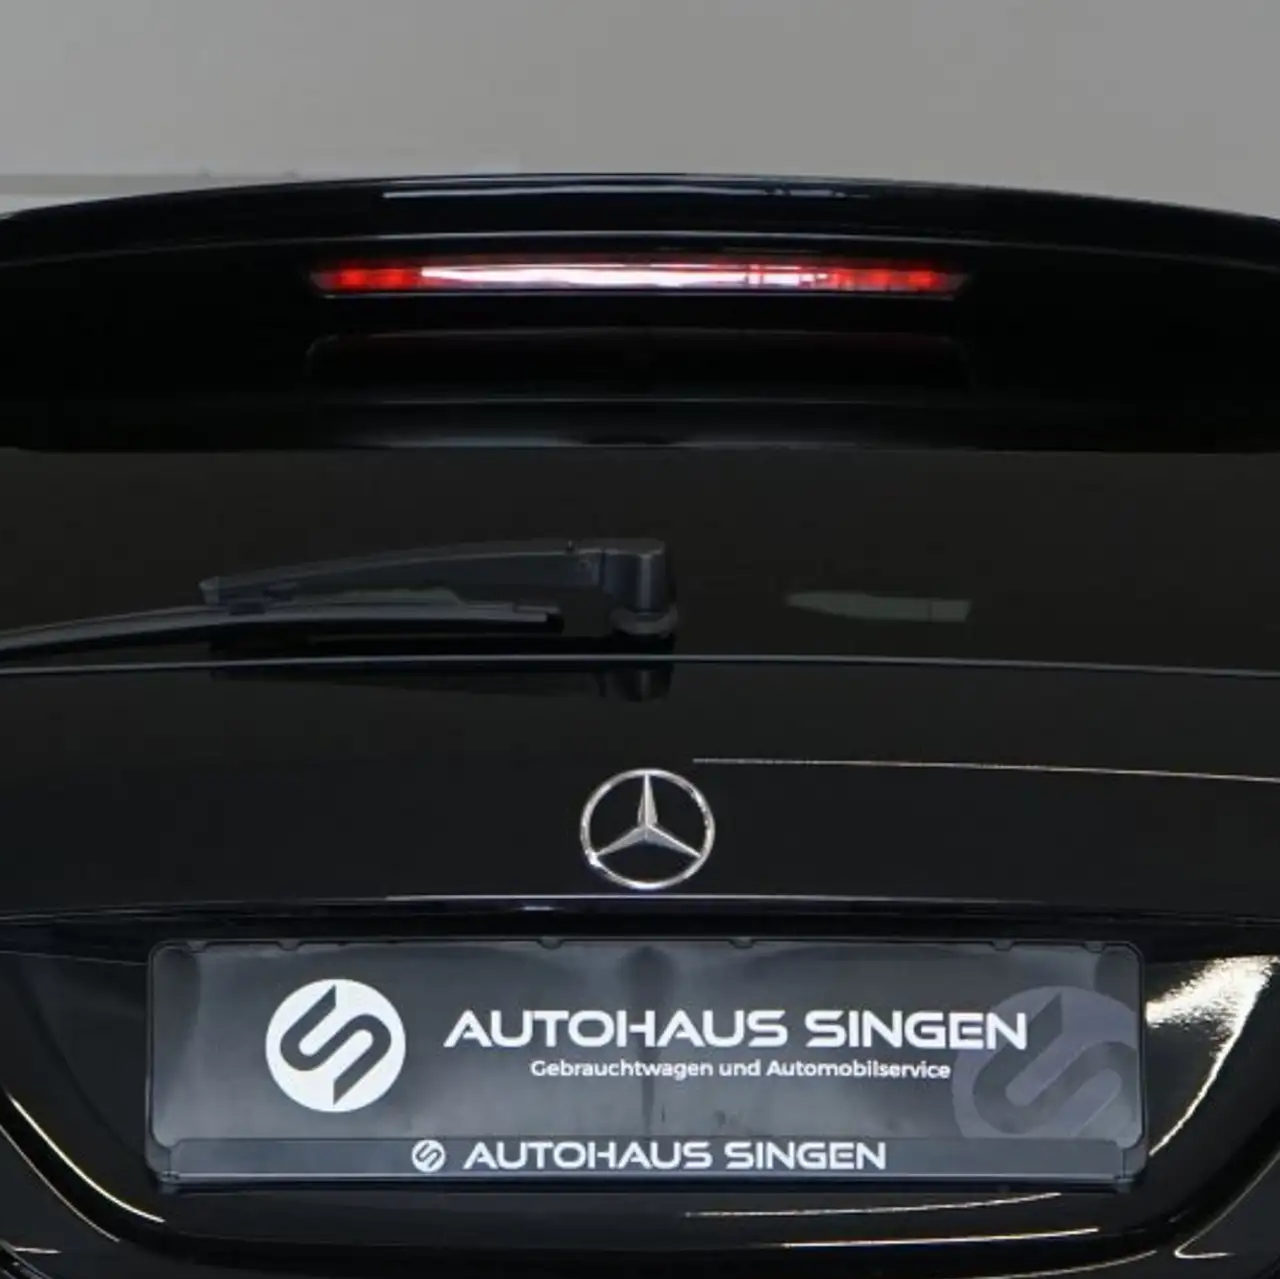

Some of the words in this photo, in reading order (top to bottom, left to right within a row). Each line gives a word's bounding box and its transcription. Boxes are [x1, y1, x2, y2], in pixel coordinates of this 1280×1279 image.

[442, 1009, 788, 1049] AUTOHAUS
[804, 1009, 1028, 1050] SINGEN
[529, 1057, 714, 1081] Gebrauchtwagen
[718, 1058, 762, 1077] und
[764, 1058, 952, 1080] Automobilservice
[462, 1140, 713, 1170] AUTOHAUS
[724, 1140, 887, 1170] SINGEN
